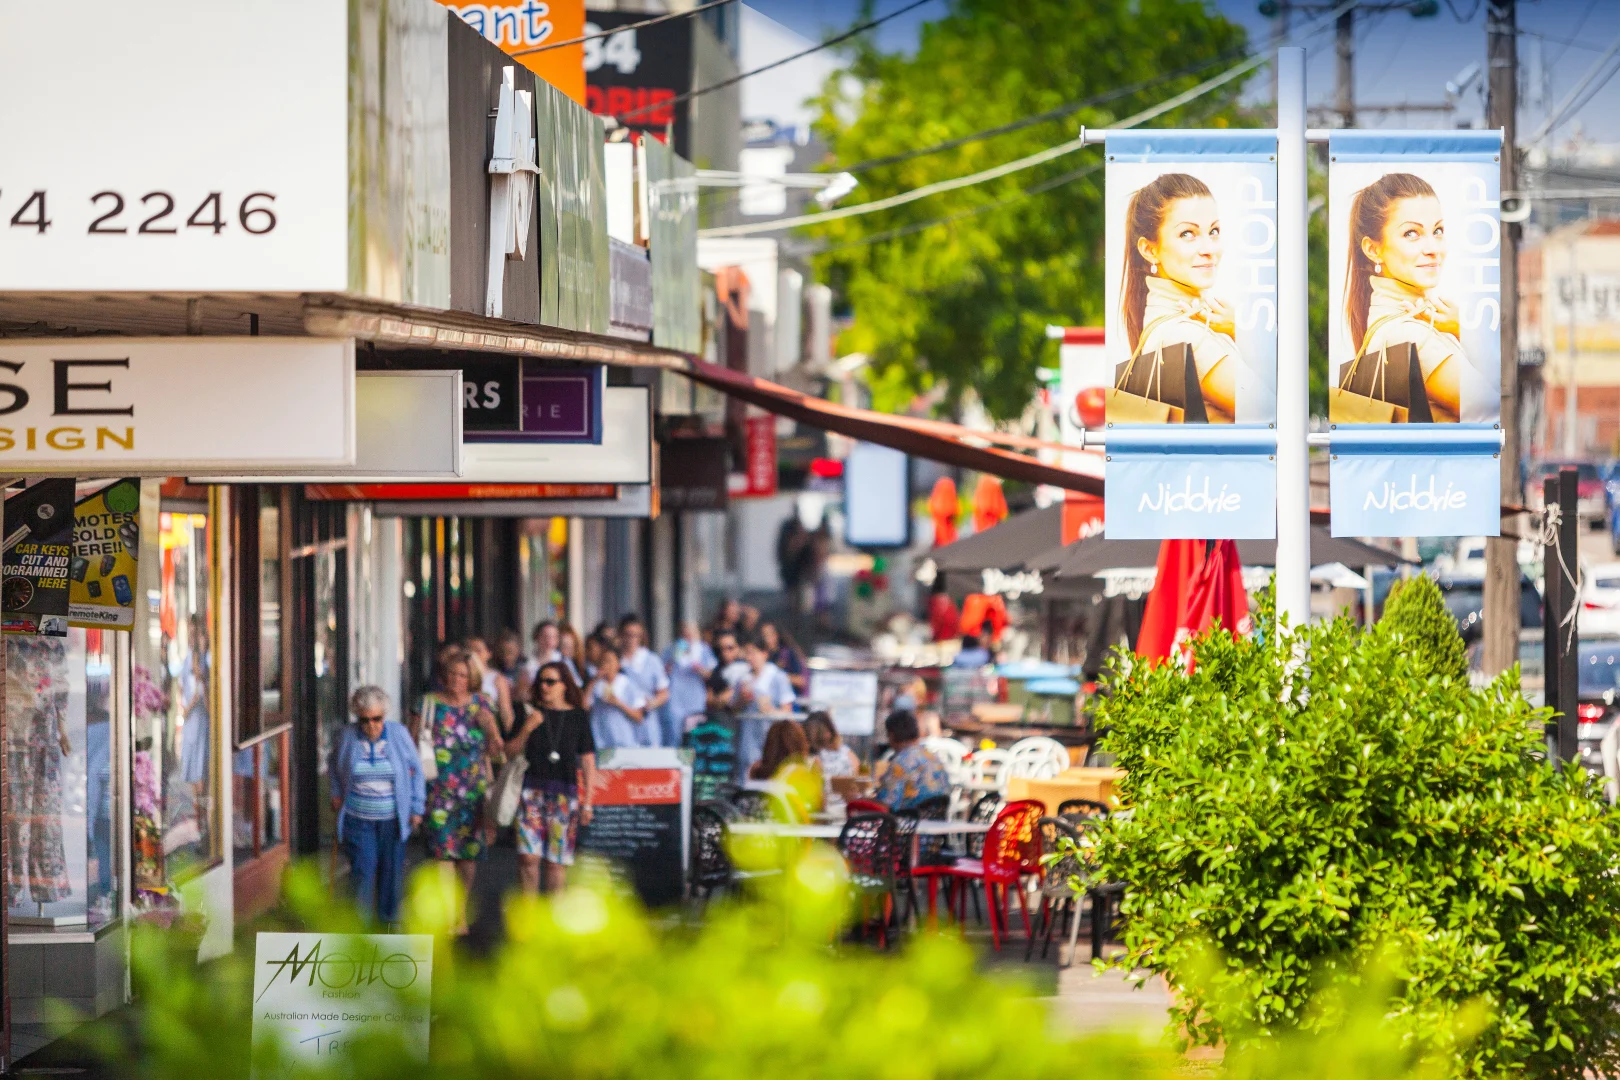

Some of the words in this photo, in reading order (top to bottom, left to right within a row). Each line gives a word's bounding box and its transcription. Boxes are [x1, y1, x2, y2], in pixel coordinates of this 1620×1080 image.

[0, 189, 52, 235] 4
[87, 190, 277, 235] 2246
[1237, 175, 1278, 333] SHOP
[1461, 175, 1500, 333] SHOP
[0, 426, 135, 452] SIGN
[1137, 480, 1242, 515] Niddrie
[1362, 474, 1468, 515] Niddrie
[15, 543, 38, 555] CAR
[40, 545, 70, 557] KEYS
[21, 554, 43, 566] CUT
[44, 556, 69, 568] AND
[37, 577, 68, 590] HERE
[69, 609, 119, 622] remoteKing
[322, 989, 361, 999] Fashion
[264, 1011, 309, 1021] Australian
[311, 1012, 340, 1021] Made
[341, 1012, 382, 1023] Designer
